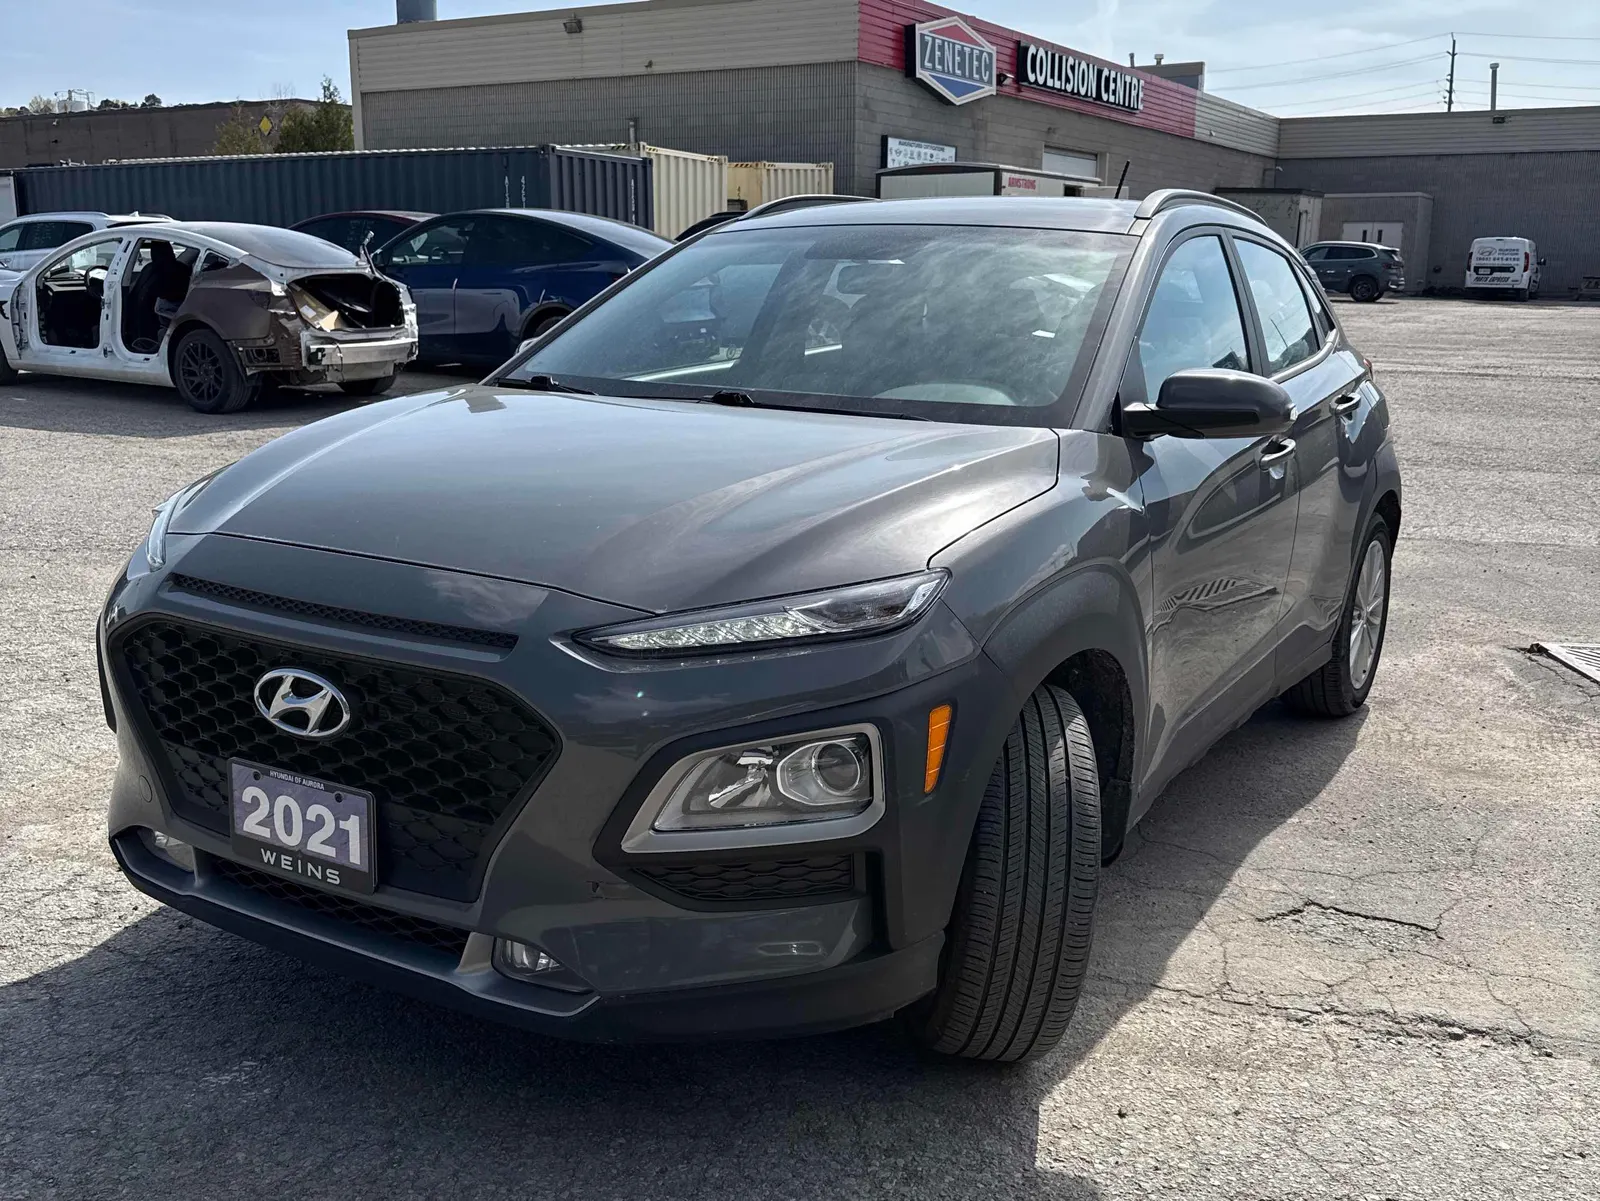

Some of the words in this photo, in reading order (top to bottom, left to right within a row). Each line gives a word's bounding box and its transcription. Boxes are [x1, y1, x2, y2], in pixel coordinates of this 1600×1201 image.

[924, 36, 990, 83] ZENETEC
[1026, 44, 1097, 98] COLLISION
[1101, 67, 1144, 110] CENTRE
[1007, 176, 1036, 190] ARMSTRONG
[269, 770, 294, 782] HYUNDAI
[302, 779, 325, 790] AURORA
[241, 786, 361, 865] 2021
[261, 848, 340, 885] WEINS
